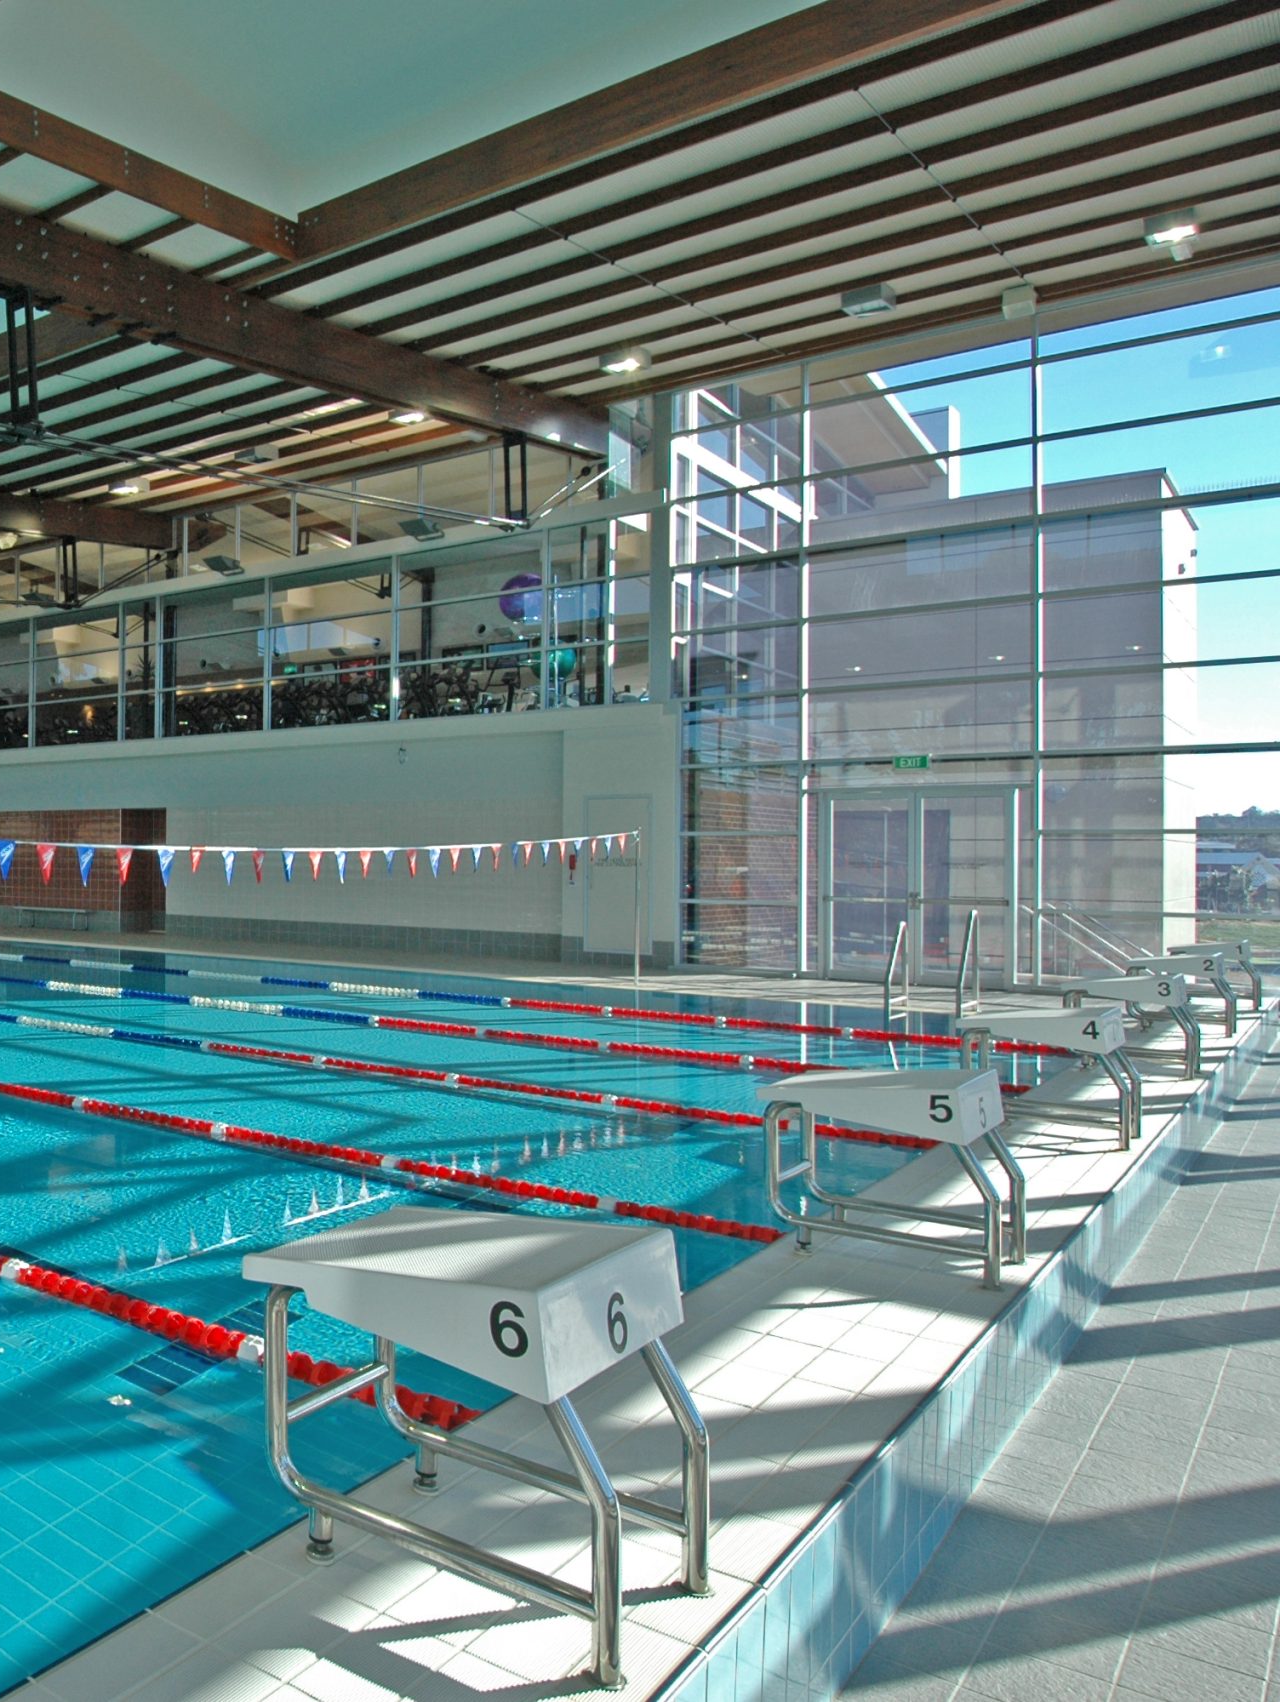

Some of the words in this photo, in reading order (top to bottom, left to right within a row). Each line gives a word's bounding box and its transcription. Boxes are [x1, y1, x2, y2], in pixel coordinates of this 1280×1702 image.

[900, 758, 920, 767] EXIT
[1236, 944, 1243, 954] 1
[1203, 959, 1214, 971] 2
[1157, 982, 1171, 996] 3
[1082, 1020, 1100, 1039] 4
[929, 1094, 953, 1123] 5
[978, 1097, 987, 1127] 5
[490, 1300, 529, 1358] 6
[607, 1291, 628, 1354] 6
